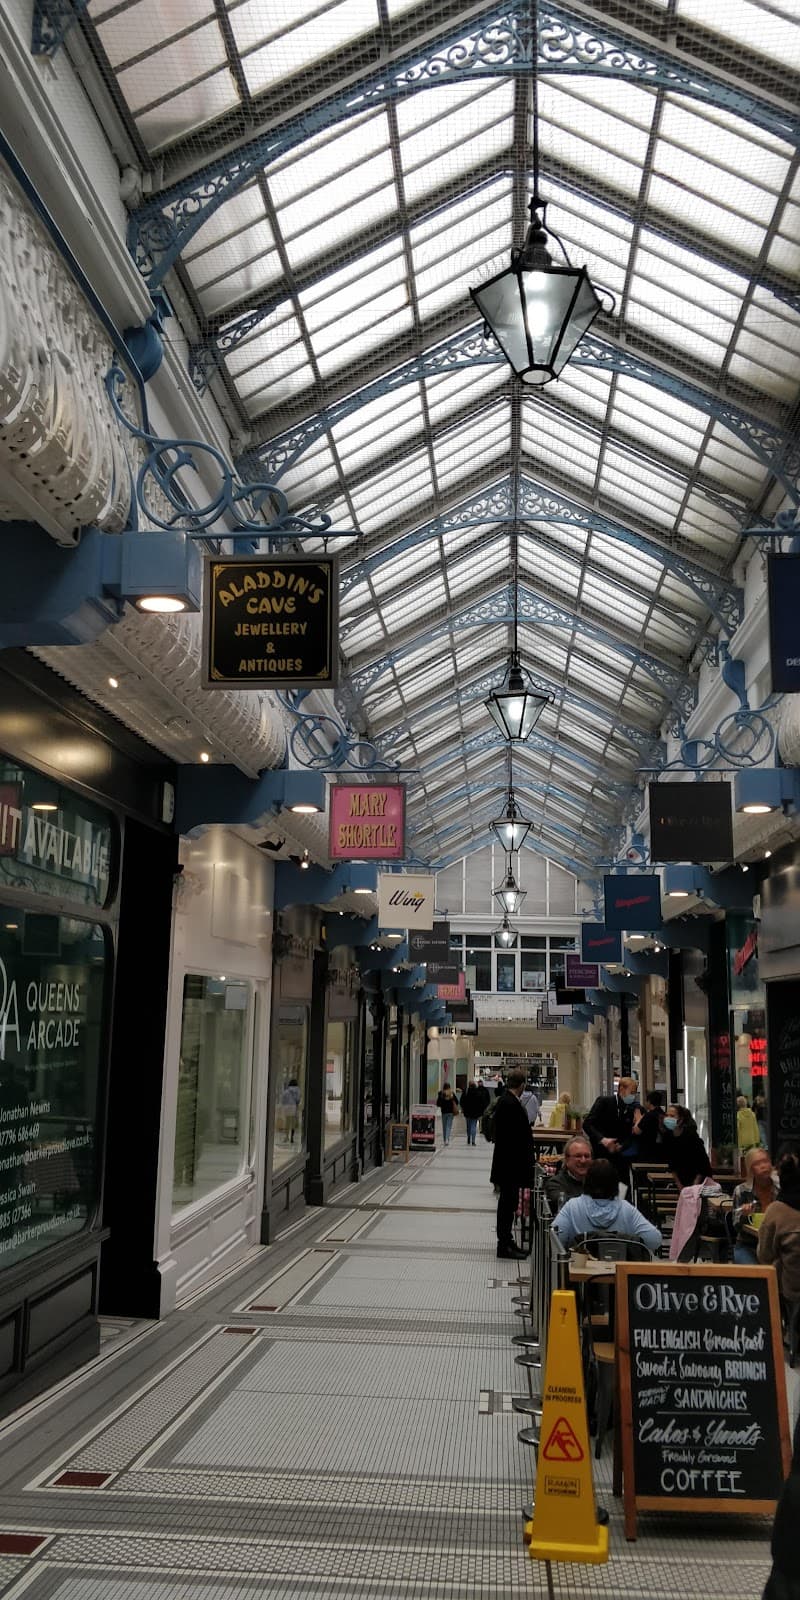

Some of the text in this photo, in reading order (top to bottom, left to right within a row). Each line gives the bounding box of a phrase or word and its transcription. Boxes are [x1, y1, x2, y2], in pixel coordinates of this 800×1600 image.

[218, 570, 324, 607] ALADDIN'S
[246, 597, 297, 614] CAVE
[234, 621, 308, 637] JEWELLERY
[265, 641, 276, 654] &
[238, 658, 303, 673] ANTIQUES
[350, 791, 388, 817] MARY
[24, 815, 110, 880] AVAILABLE
[338, 823, 397, 849] SHORTLE
[389, 889, 426, 913] Wing
[26, 981, 80, 1013] QUEENS
[26, 1019, 80, 1051] ARCADE
[635, 1282, 761, 1320] Olive & Rye
[634, 1325, 767, 1357] FULL ENGLISH Breakfast
[635, 1352, 671, 1378] Sweet
[724, 1360, 767, 1382] BRUNCH
[673, 1387, 748, 1411] SANDWICHES
[638, 1416, 691, 1444] Cakes
[660, 1468, 746, 1493] COFFEE
